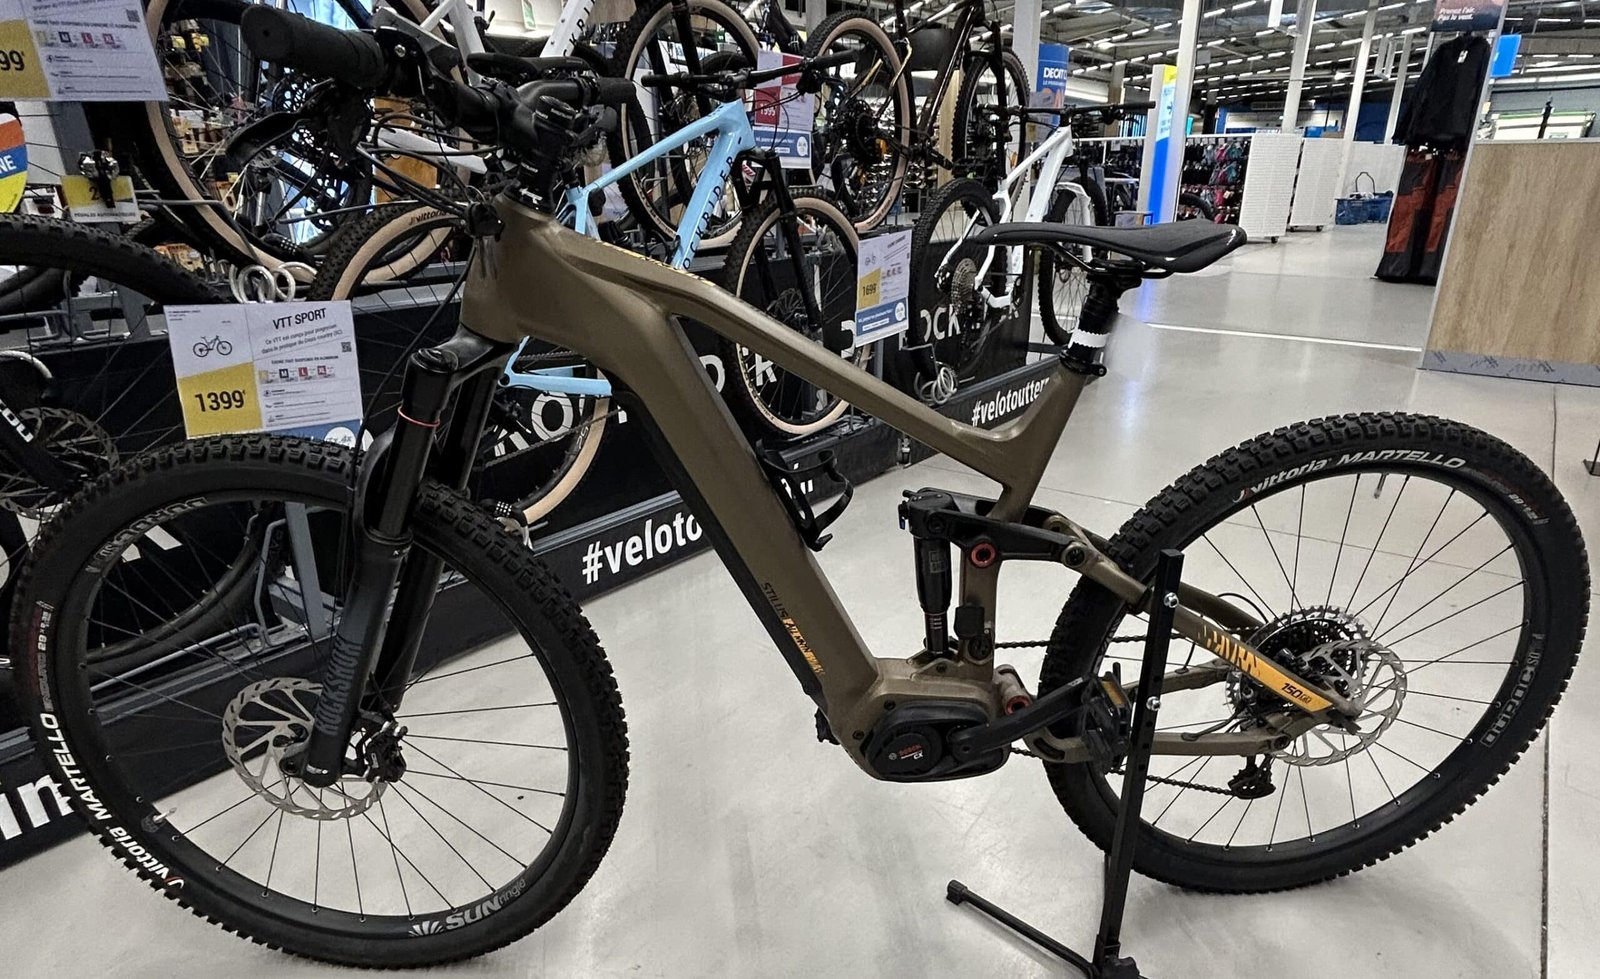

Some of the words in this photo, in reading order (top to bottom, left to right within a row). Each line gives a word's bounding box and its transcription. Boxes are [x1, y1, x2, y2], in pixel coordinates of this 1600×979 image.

[0, 154, 17, 173] NE
[681, 156, 735, 270] OCKRIDER
[272, 315, 292, 330] VTT
[294, 307, 327, 325] SPORT
[971, 377, 1050, 428] #velotoutter
[1250, 458, 1329, 493] vittoria
[1337, 449, 1467, 469] MARTELLO
[582, 512, 703, 585] #veloto
[40, 713, 112, 820] MARTELLO
[109, 827, 170, 880] vittoria
